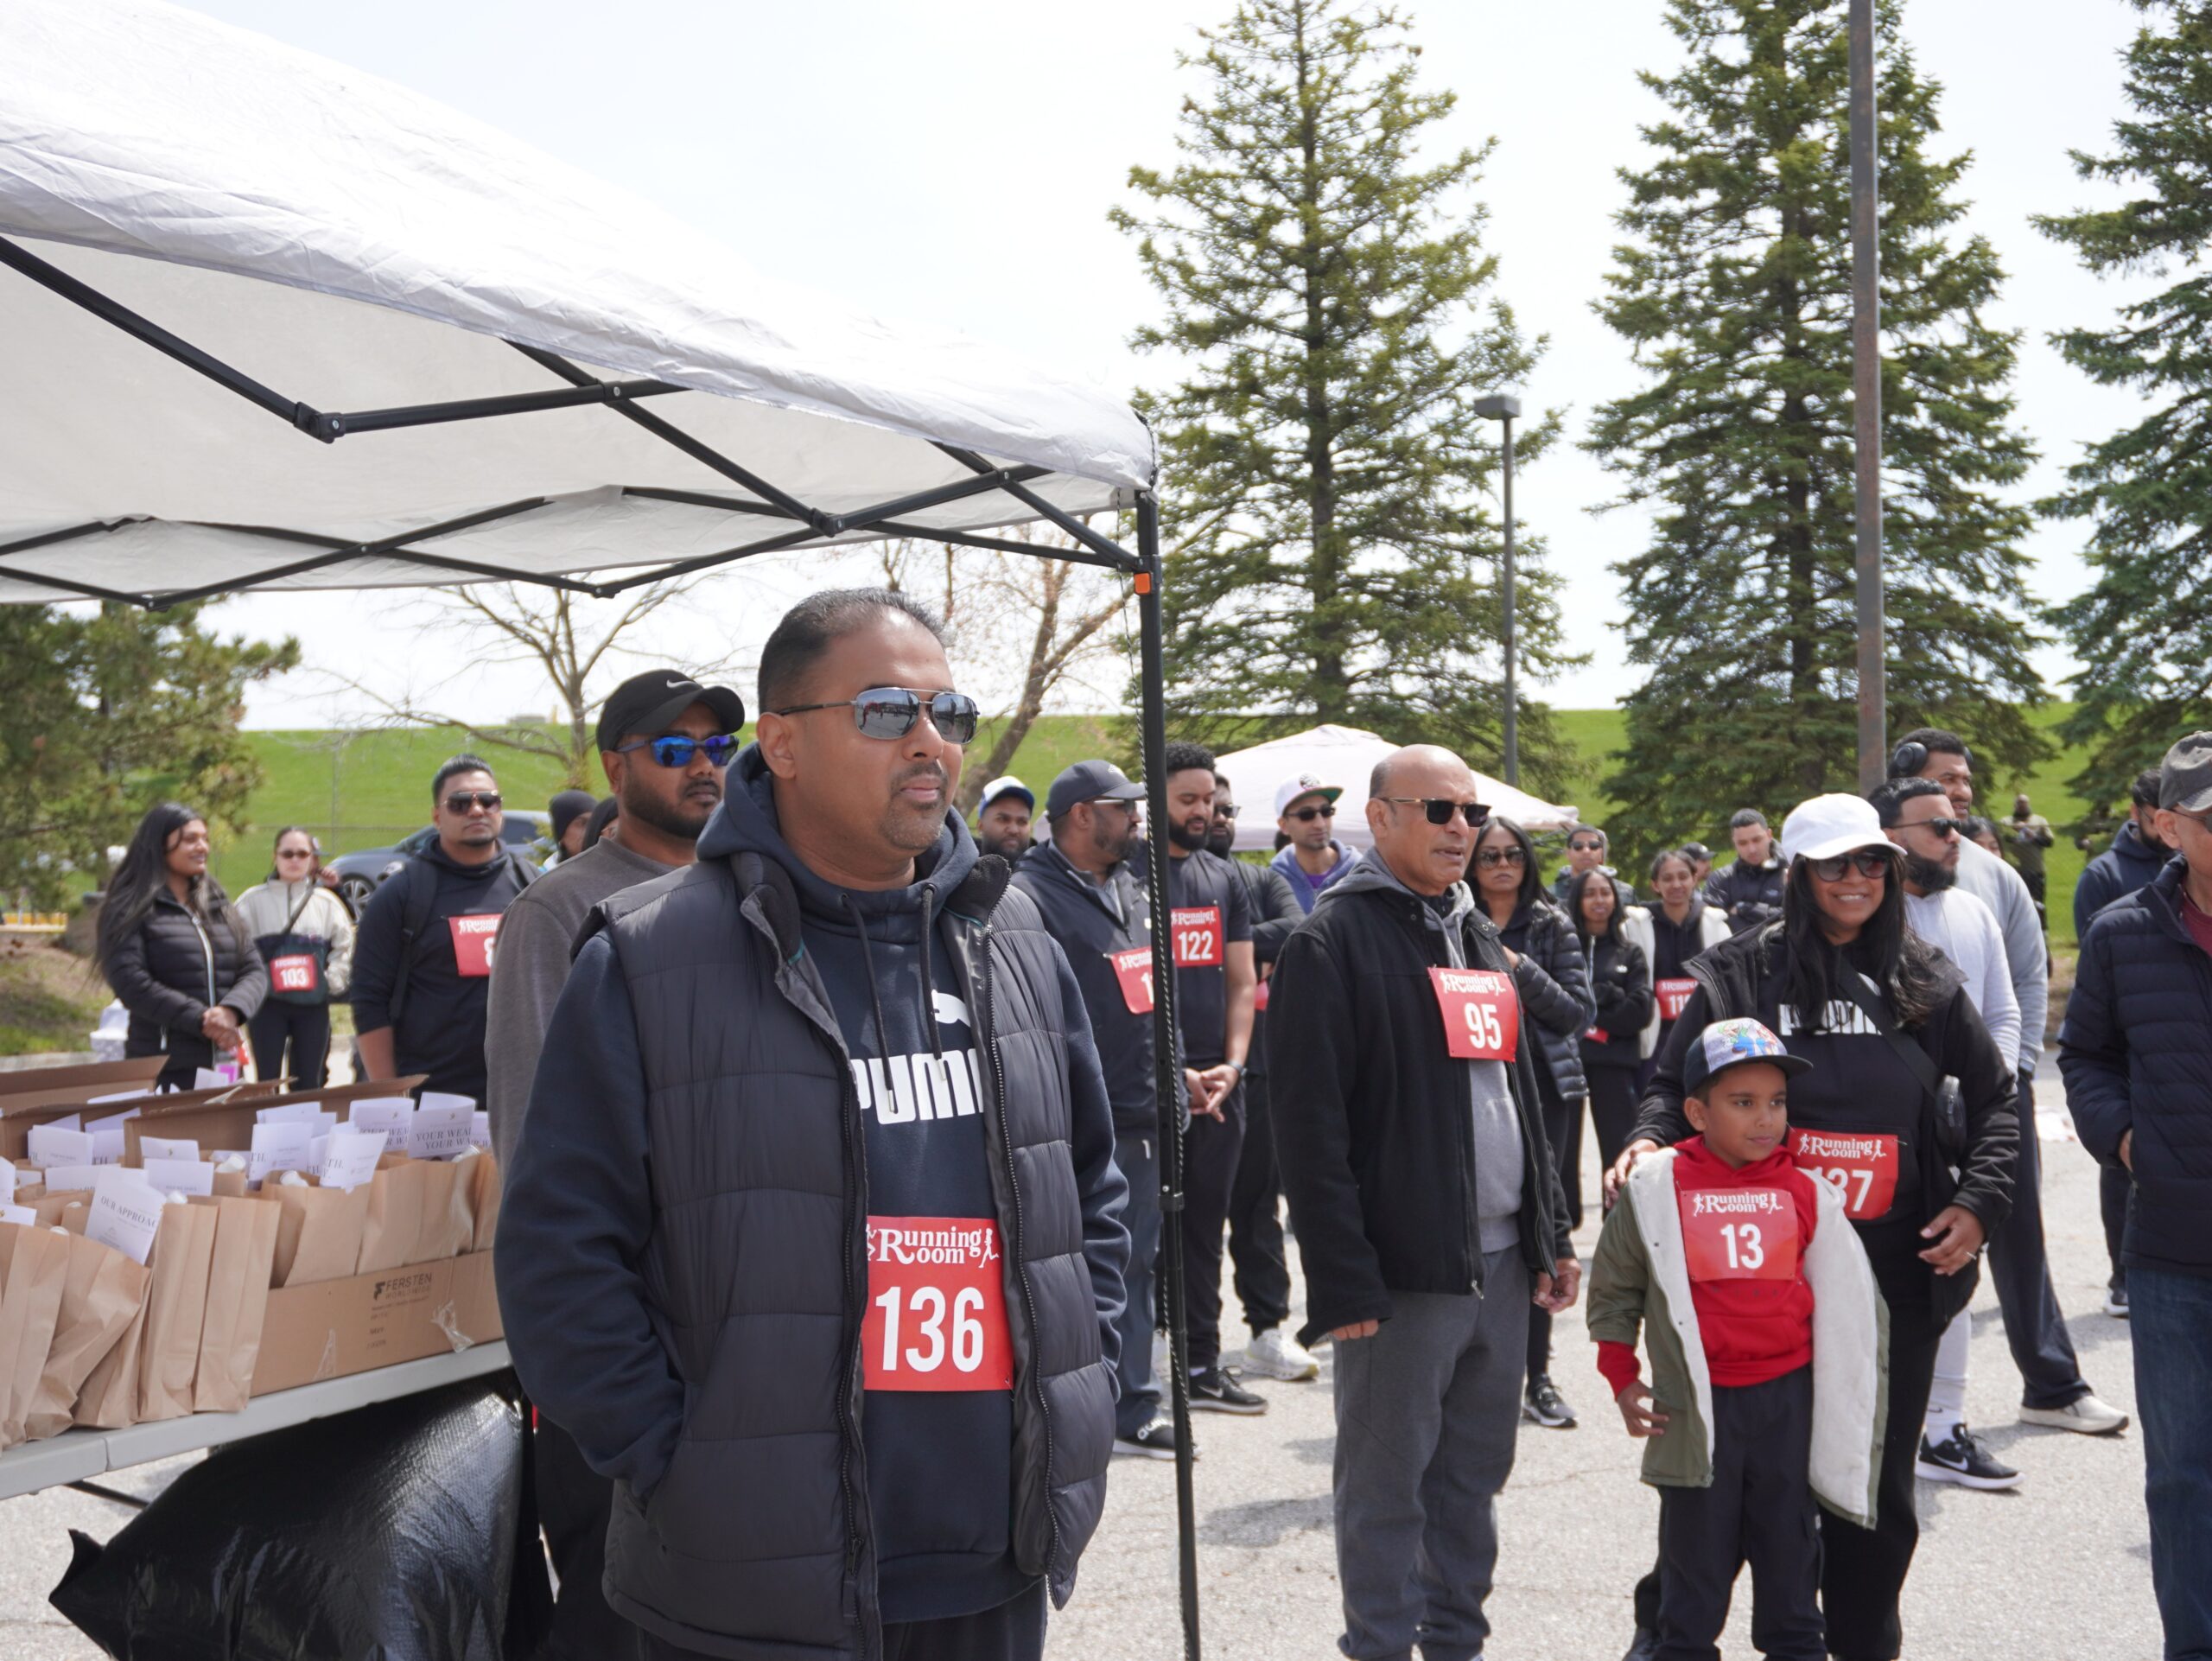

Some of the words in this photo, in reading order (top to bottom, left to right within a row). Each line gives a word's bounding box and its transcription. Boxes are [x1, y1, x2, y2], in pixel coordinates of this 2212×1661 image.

[1178, 930, 1213, 961] 122
[280, 967, 307, 988] 103
[1446, 973, 1493, 993] Running
[1465, 1002, 1502, 1050] 95
[416, 1131, 443, 1142] YOUR
[425, 1139, 453, 1150] YOUR
[1810, 1136, 1873, 1157] Running
[1815, 1166, 1873, 1212] 37
[101, 1196, 116, 1211] OUR
[1705, 1192, 1769, 1213] Running
[876, 1225, 982, 1264] Running
[1719, 1224, 1764, 1269] 13
[385, 1272, 432, 1291] FERSTEN
[875, 1286, 984, 1372] 136
